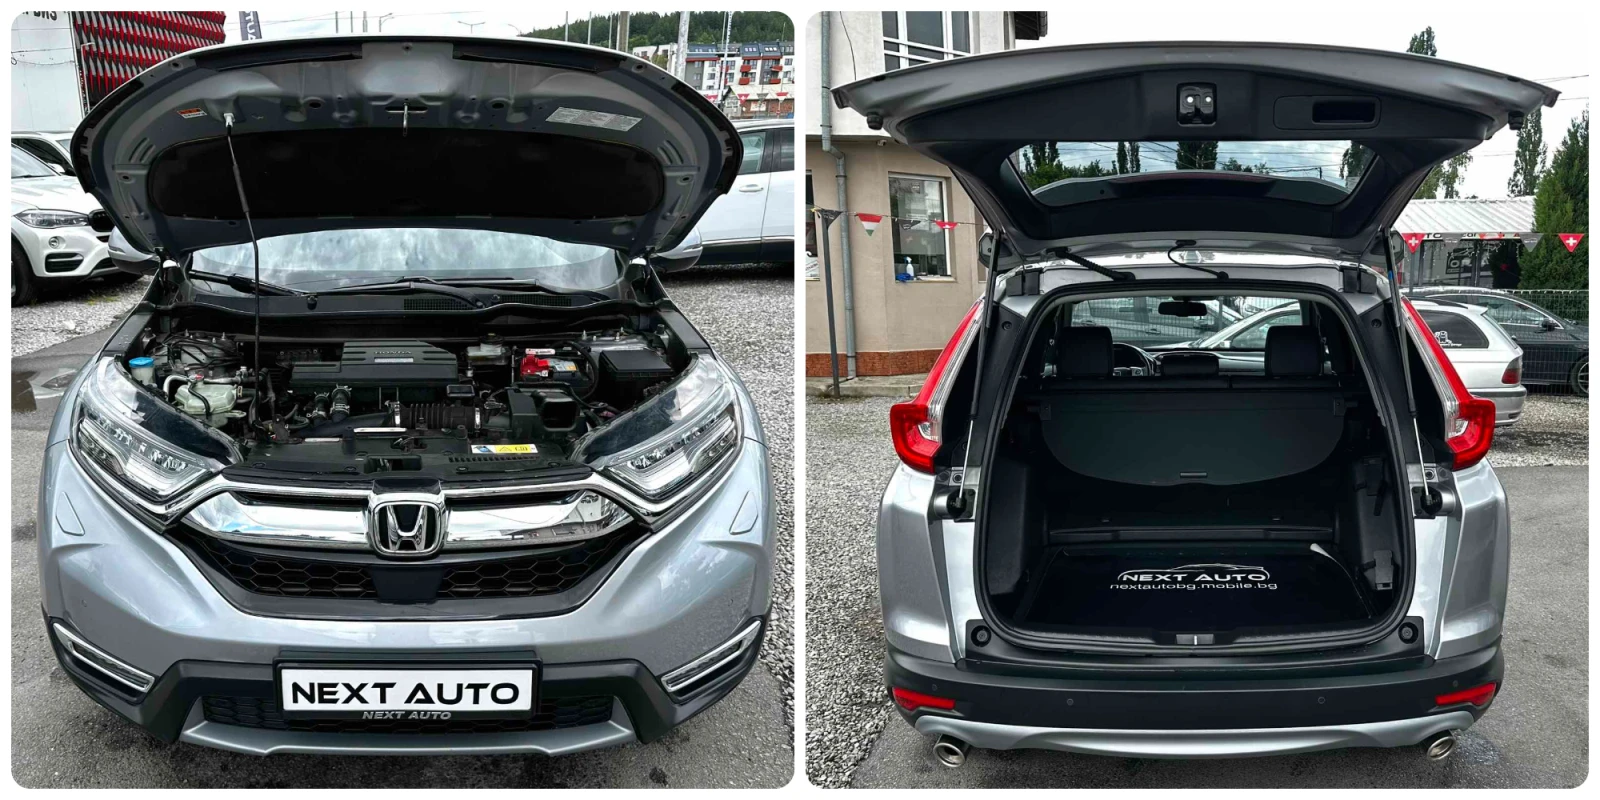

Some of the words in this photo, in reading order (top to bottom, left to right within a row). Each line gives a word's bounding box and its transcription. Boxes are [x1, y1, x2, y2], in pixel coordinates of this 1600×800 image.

[245, 11, 256, 40] TUA
[291, 681, 397, 704] NEXT
[404, 682, 520, 705] AUTO
[362, 711, 405, 720] NEXT
[408, 711, 452, 720] AUTO
